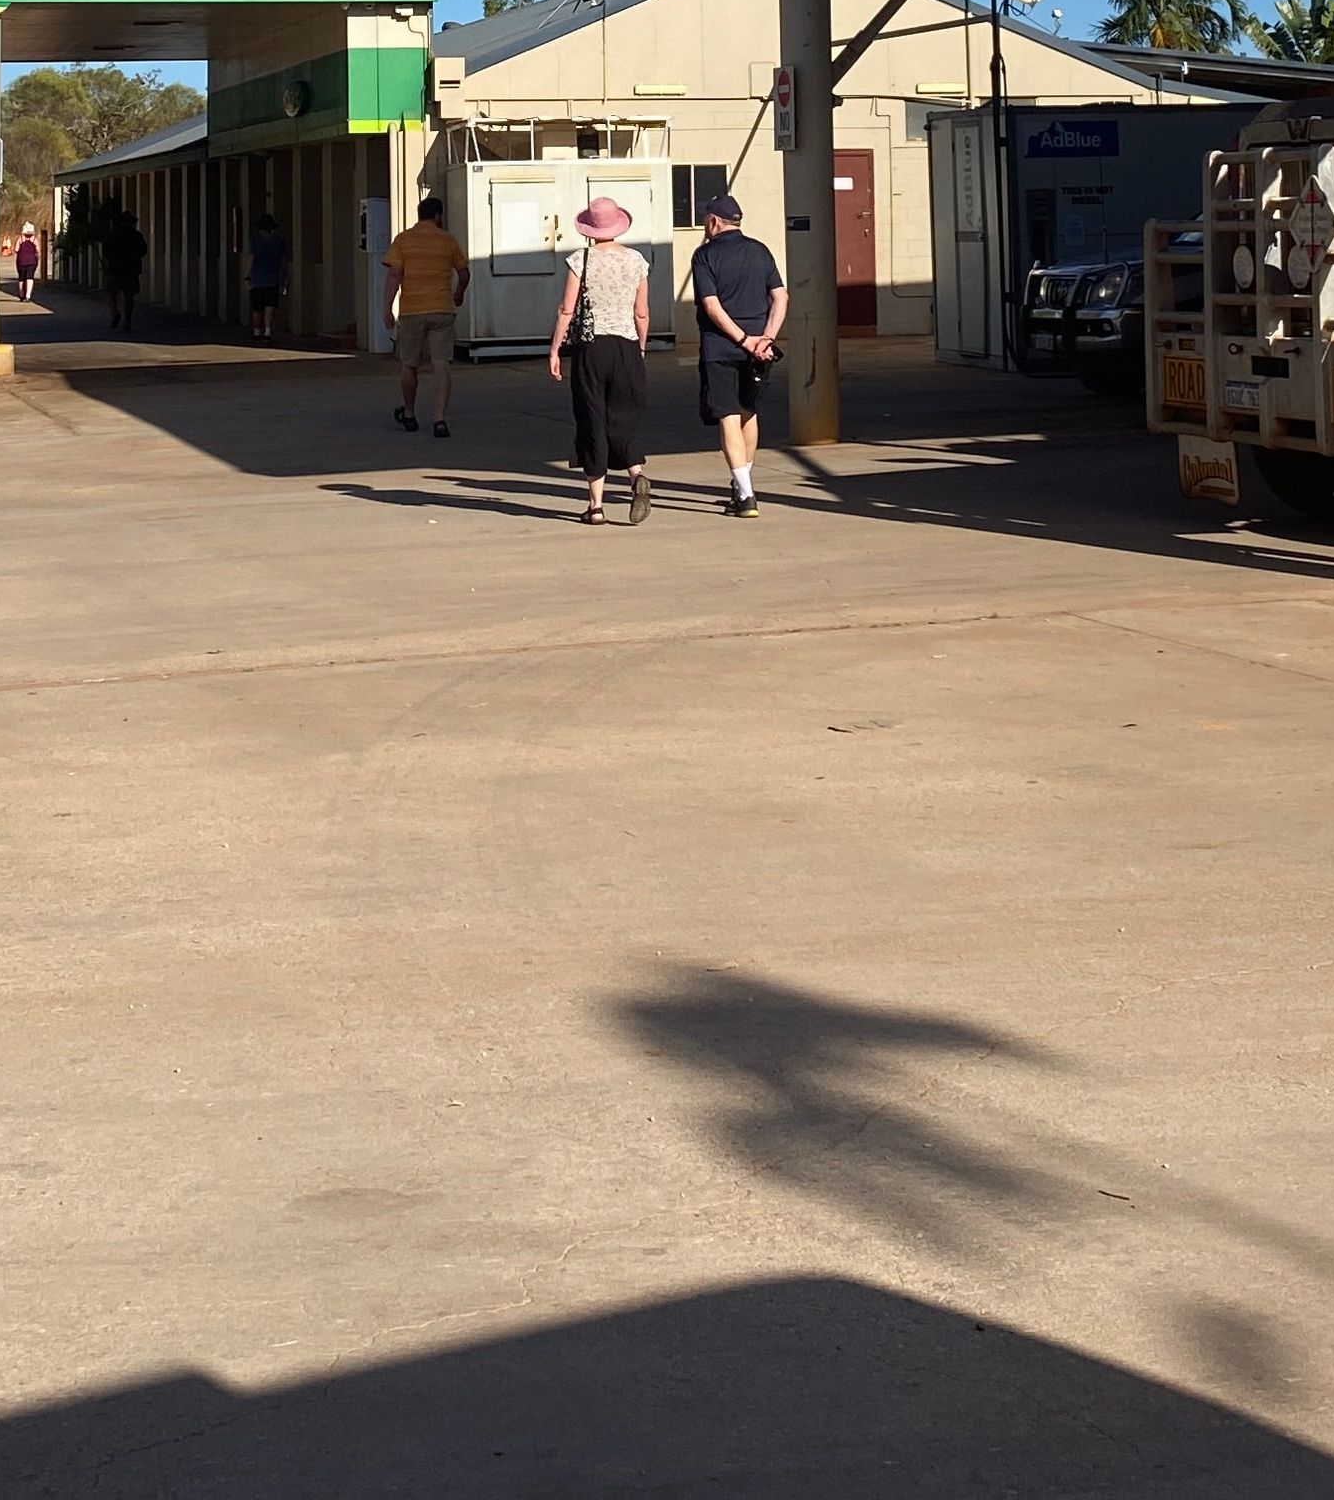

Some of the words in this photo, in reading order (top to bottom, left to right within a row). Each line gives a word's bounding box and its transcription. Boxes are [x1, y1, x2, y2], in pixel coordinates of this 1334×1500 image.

[780, 111, 790, 131] NO
[1041, 130, 1101, 148] AdBlue
[964, 134, 974, 228] AdBlue
[1168, 362, 1205, 399] ROAD
[1183, 454, 1234, 491] Colonial
